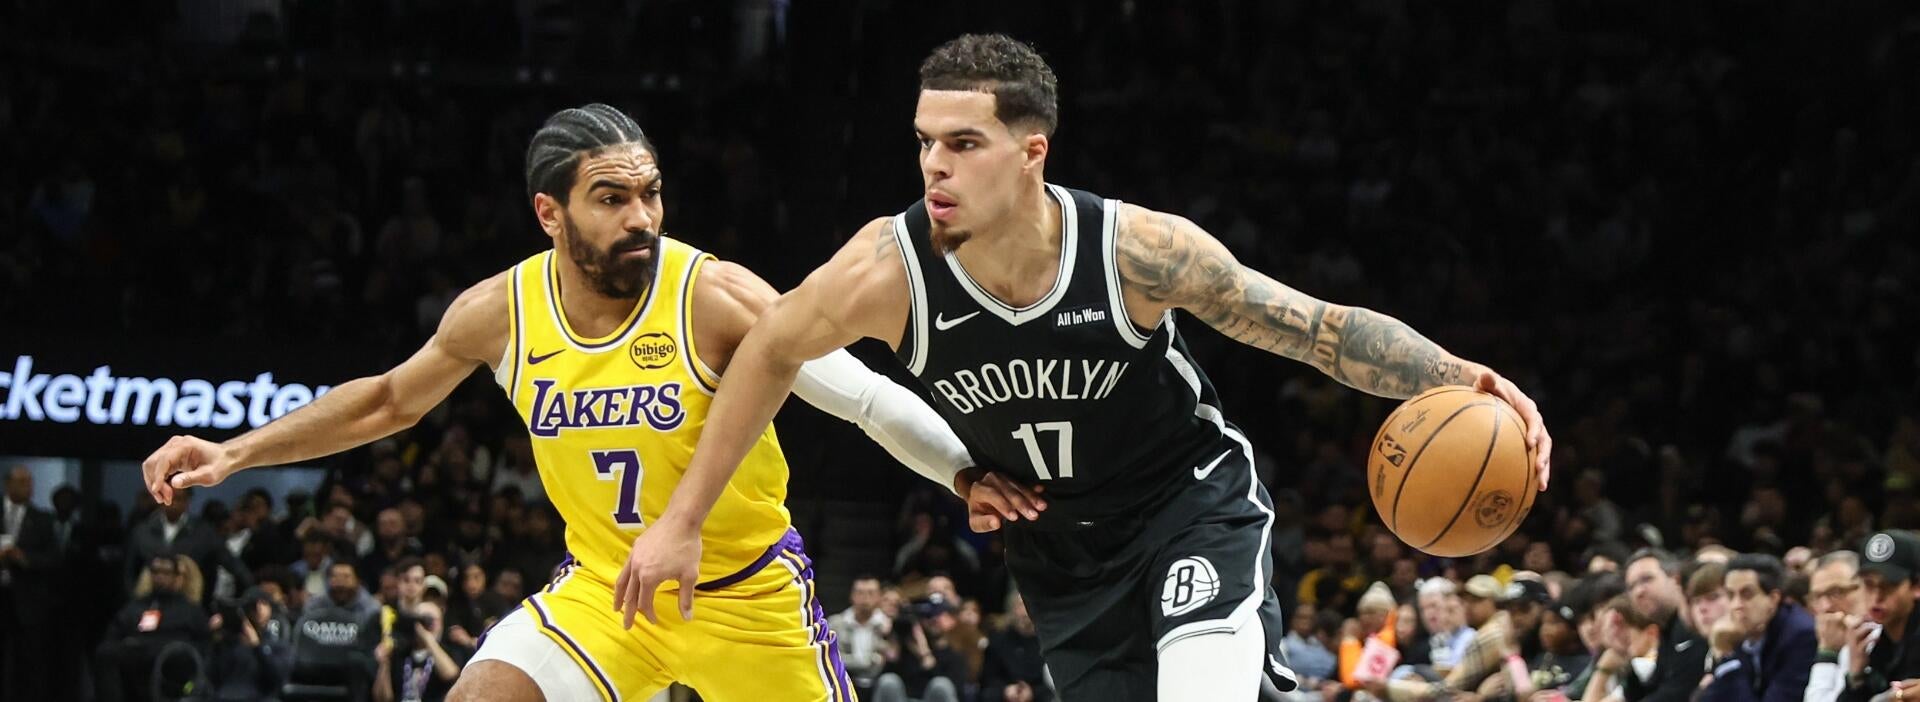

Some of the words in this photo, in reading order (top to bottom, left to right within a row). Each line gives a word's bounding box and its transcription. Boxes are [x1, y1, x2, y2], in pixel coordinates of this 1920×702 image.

[1057, 311, 1071, 327] All
[1072, 311, 1083, 325] In
[1082, 308, 1106, 323] Won
[633, 342, 675, 358] bibigo
[0, 354, 331, 429] ketmaste
[529, 379, 685, 437] LAKERS
[933, 358, 1129, 415] BROOKLYN
[1011, 420, 1074, 481] 17
[590, 448, 646, 529] 7
